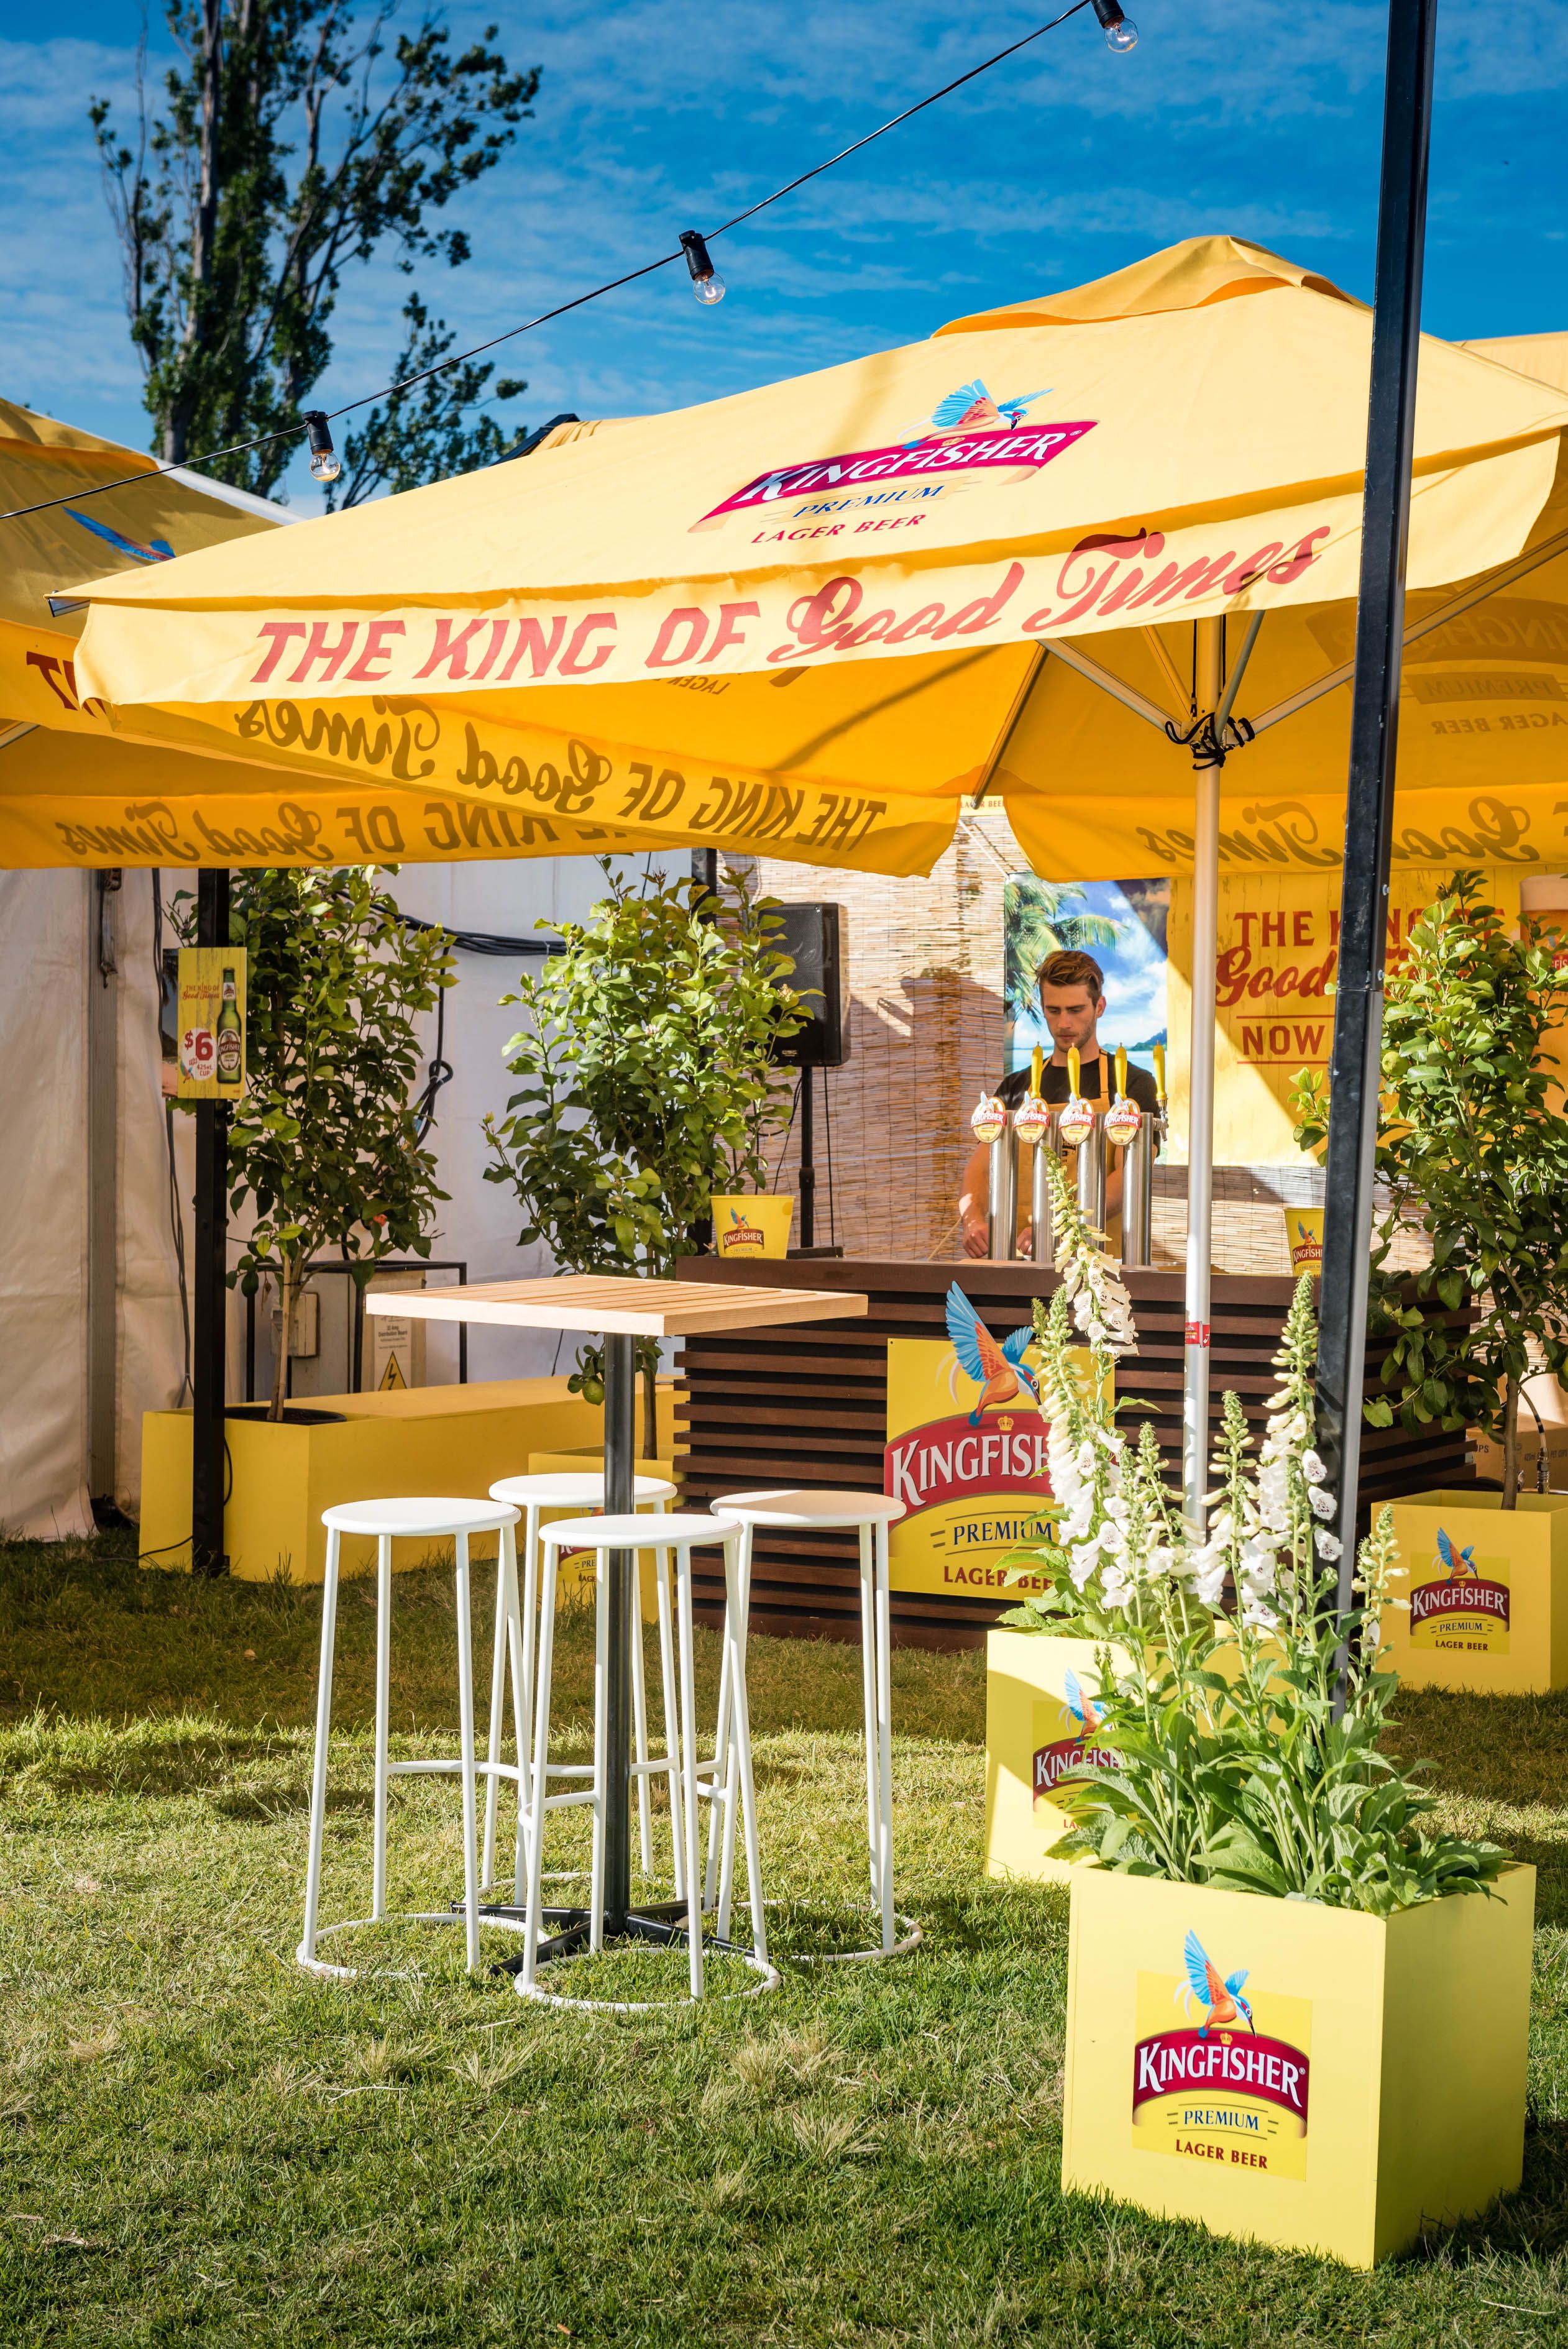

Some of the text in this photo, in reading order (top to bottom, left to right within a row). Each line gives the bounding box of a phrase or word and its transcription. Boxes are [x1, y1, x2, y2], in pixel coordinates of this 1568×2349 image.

[732, 433, 1067, 503] KINGFISHER
[792, 485, 946, 518] PREMIUM
[751, 514, 927, 544] LAGER BEER
[249, 620, 406, 683] THE
[411, 612, 617, 680] KING
[644, 600, 761, 669] OF
[766, 562, 1025, 664] Good
[1021, 526, 1331, 633] Times
[1233, 910, 1315, 947] THE
[1215, 945, 1337, 1007] Good
[185, 1030, 213, 1061] $6
[1242, 1025, 1326, 1055] NOW
[724, 1232, 763, 1246] KINGFISHER
[891, 1433, 1050, 1506] KINGFISH
[1017, 1572, 1052, 1590] BEE
[1413, 1588, 1506, 1616] KINGFISHER
[1439, 1622, 1483, 1632] PREMIUM
[1436, 1640, 1488, 1651] LAGER BEER
[1139, 2042, 1303, 2108] KINGFISHER
[1184, 2110, 1259, 2131] PREMIUM
[1175, 2139, 1268, 2169] LAGER BEER
